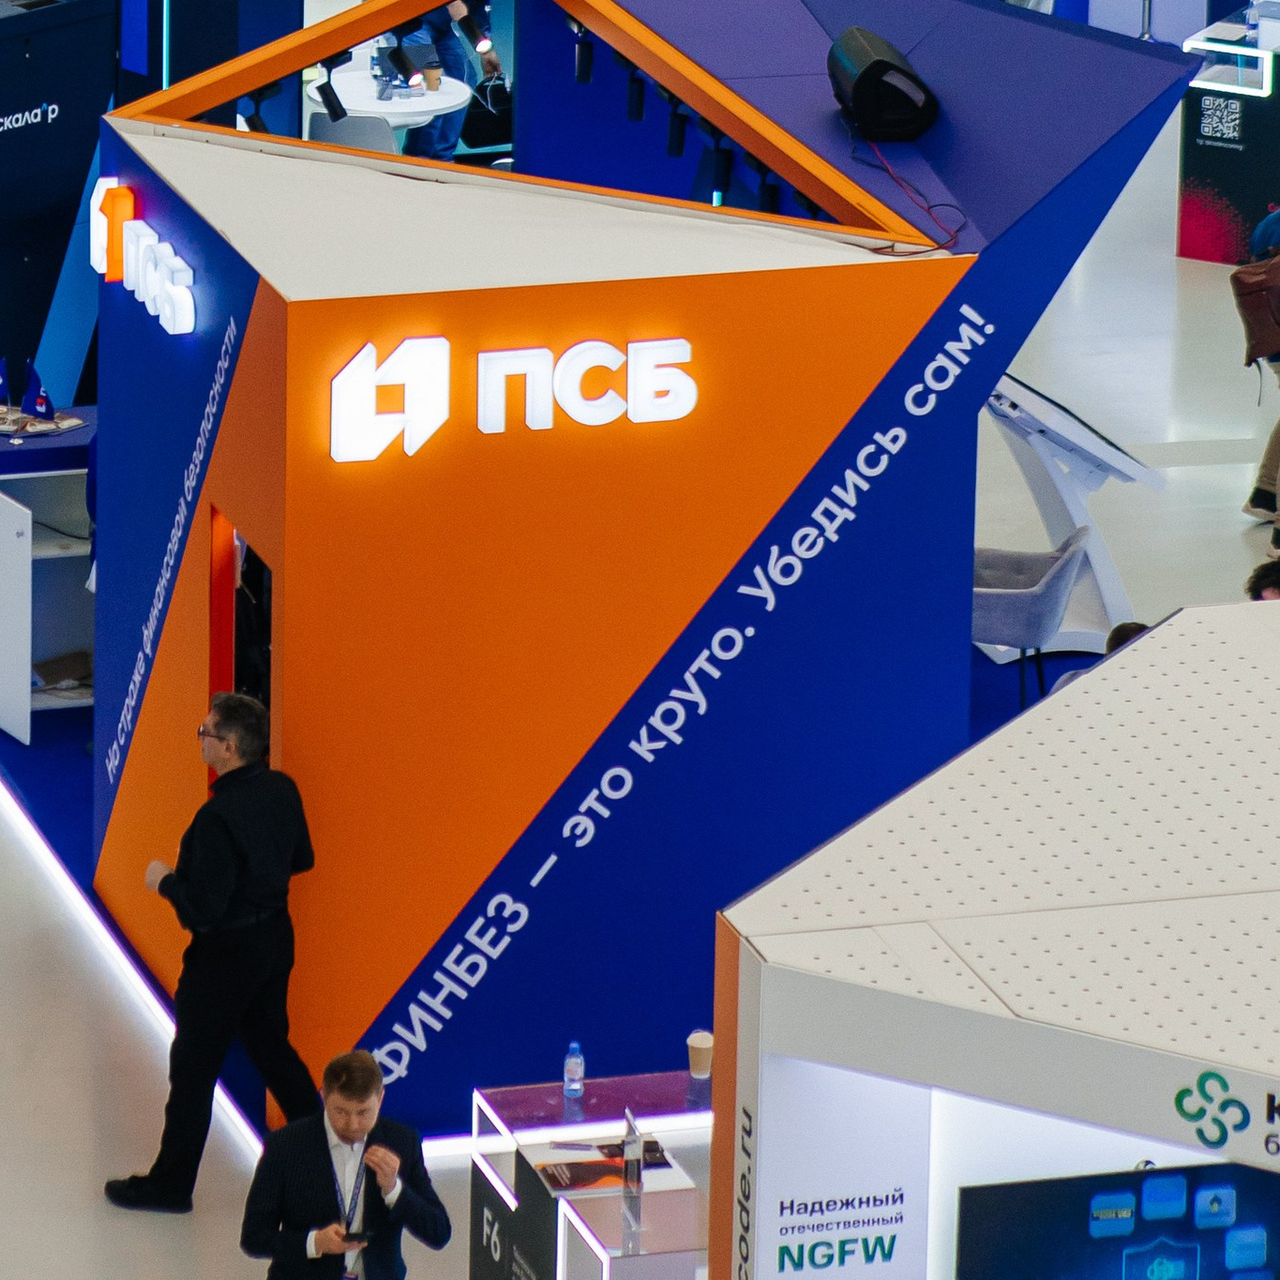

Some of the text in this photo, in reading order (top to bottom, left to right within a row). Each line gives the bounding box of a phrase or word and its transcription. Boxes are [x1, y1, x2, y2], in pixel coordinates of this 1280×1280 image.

[477, 337, 699, 435] ПСБ
[105, 315, 238, 784] На страже финансовой безопасности
[561, 764, 635, 850] это
[627, 622, 756, 764] круто.
[737, 423, 908, 612] Убедись
[903, 301, 997, 417] сам!
[778, 1187, 905, 1217] Надежный
[779, 1212, 904, 1236] отечественный
[778, 1234, 897, 1273] NGFW
